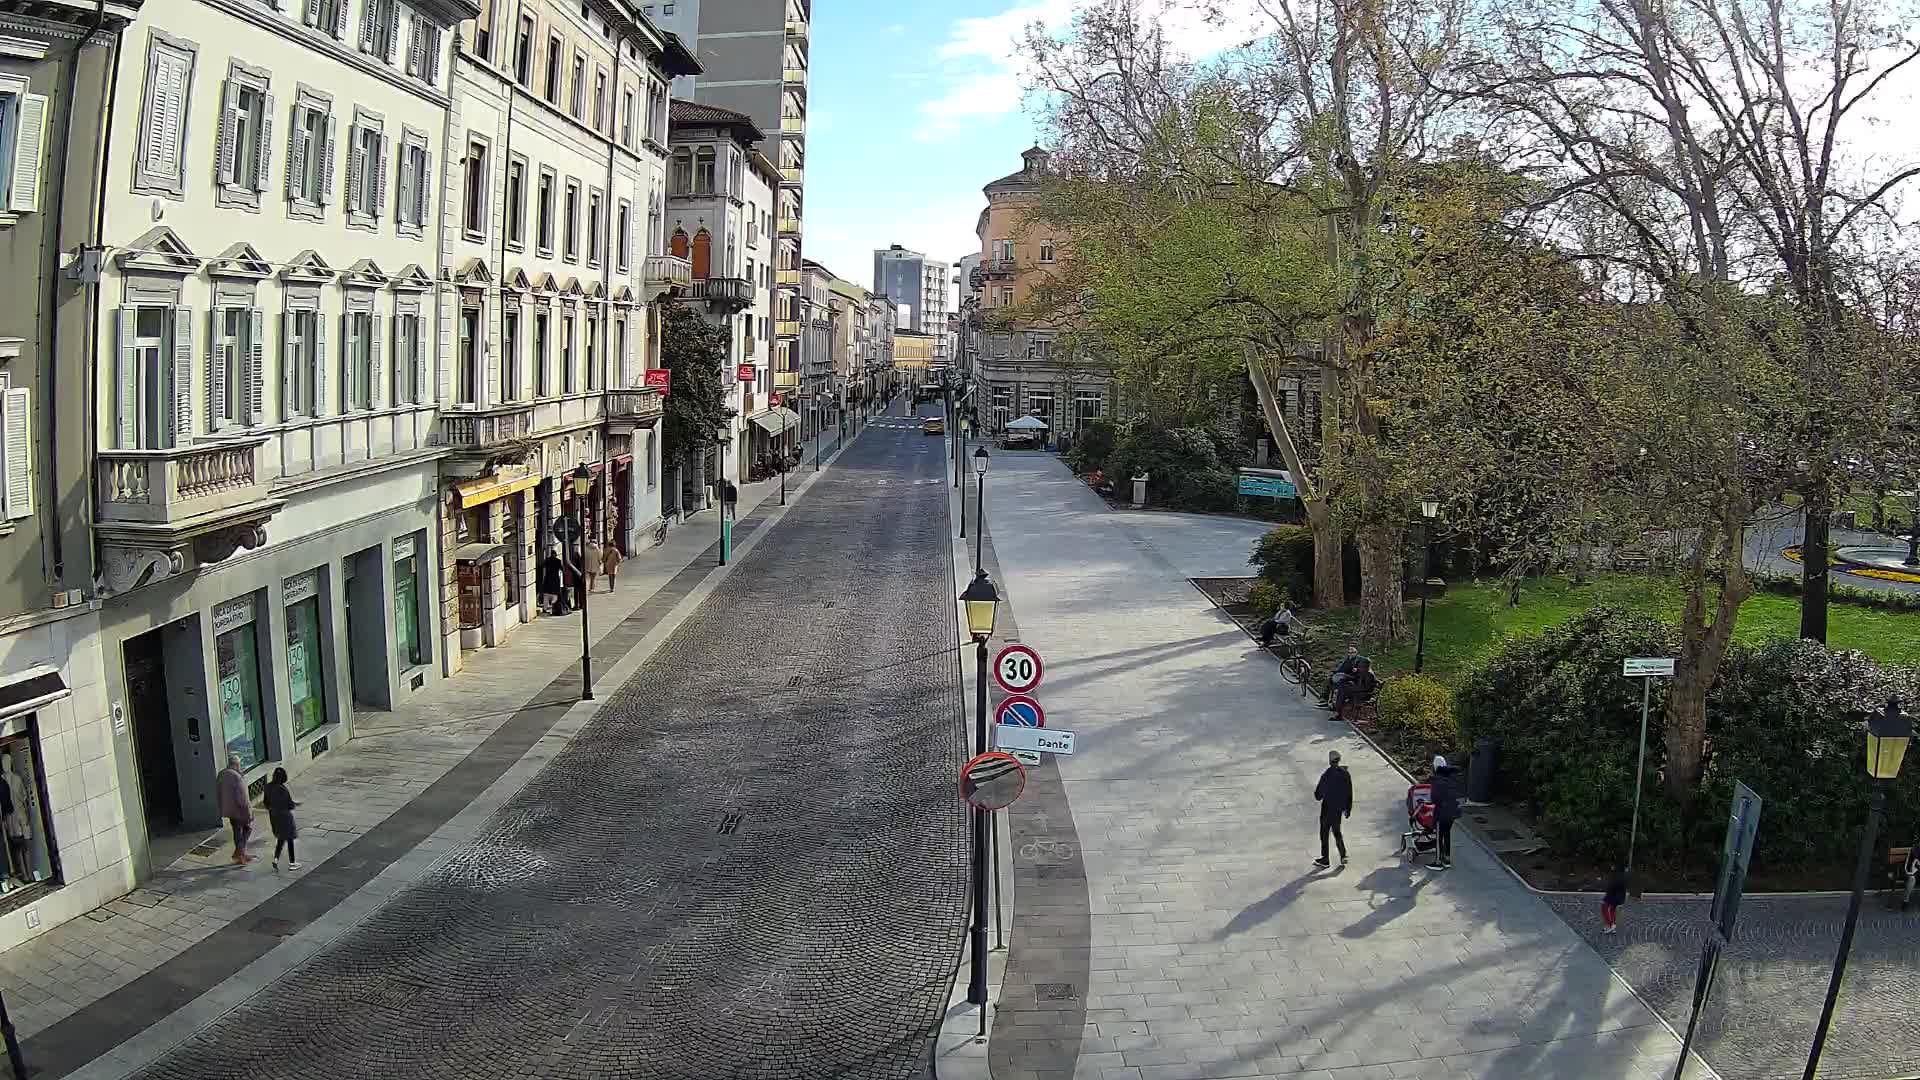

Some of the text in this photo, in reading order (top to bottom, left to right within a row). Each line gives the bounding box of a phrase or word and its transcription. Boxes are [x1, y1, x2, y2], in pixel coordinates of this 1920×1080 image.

[1005, 658, 1032, 680] 30
[222, 676, 240, 700] 130
[1038, 738, 1069, 750] Dante
